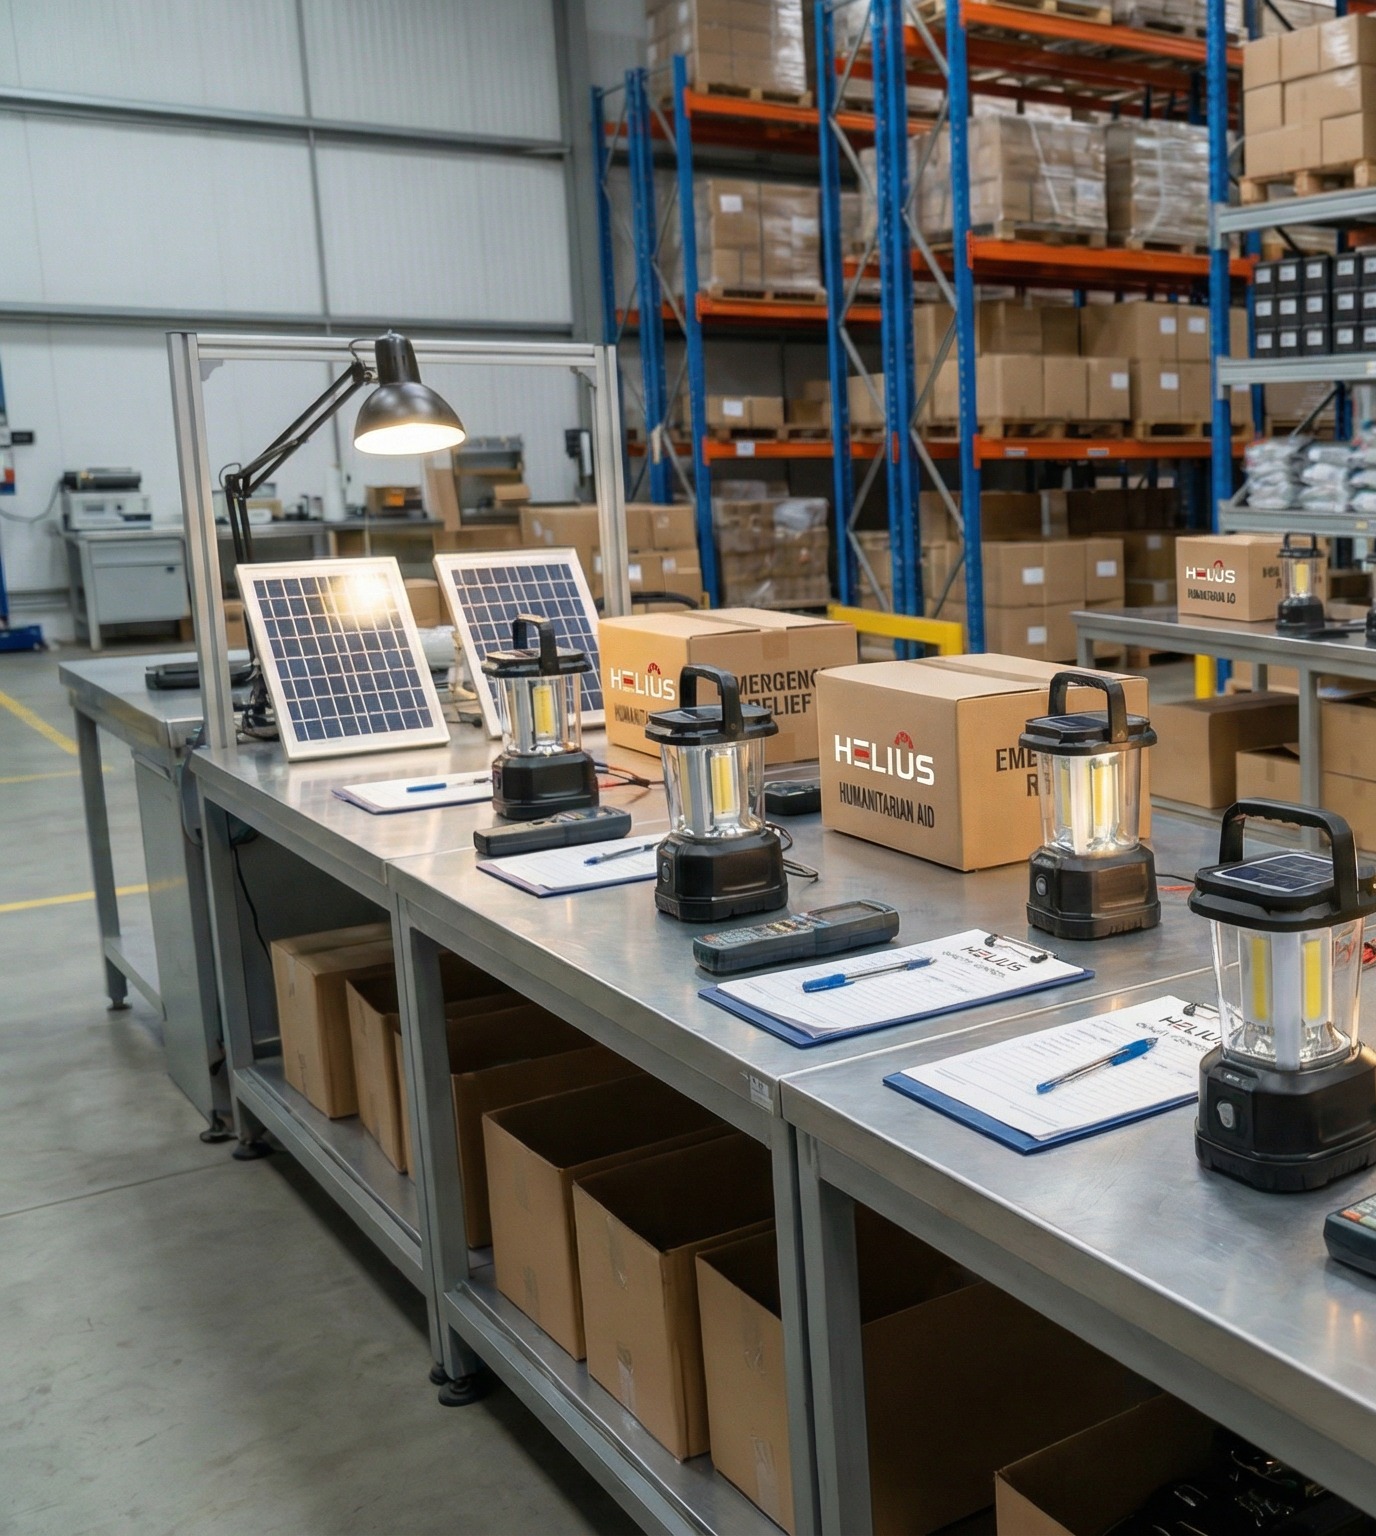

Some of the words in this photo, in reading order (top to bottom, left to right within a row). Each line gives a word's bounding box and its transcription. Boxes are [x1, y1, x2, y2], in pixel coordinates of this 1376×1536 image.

[610, 667, 676, 701] HELIUS
[833, 734, 935, 786] HELIUS
[839, 781, 914, 824] HUMANITARIAN
[917, 803, 935, 828] AID
[1159, 1016, 1222, 1045] HELIU
